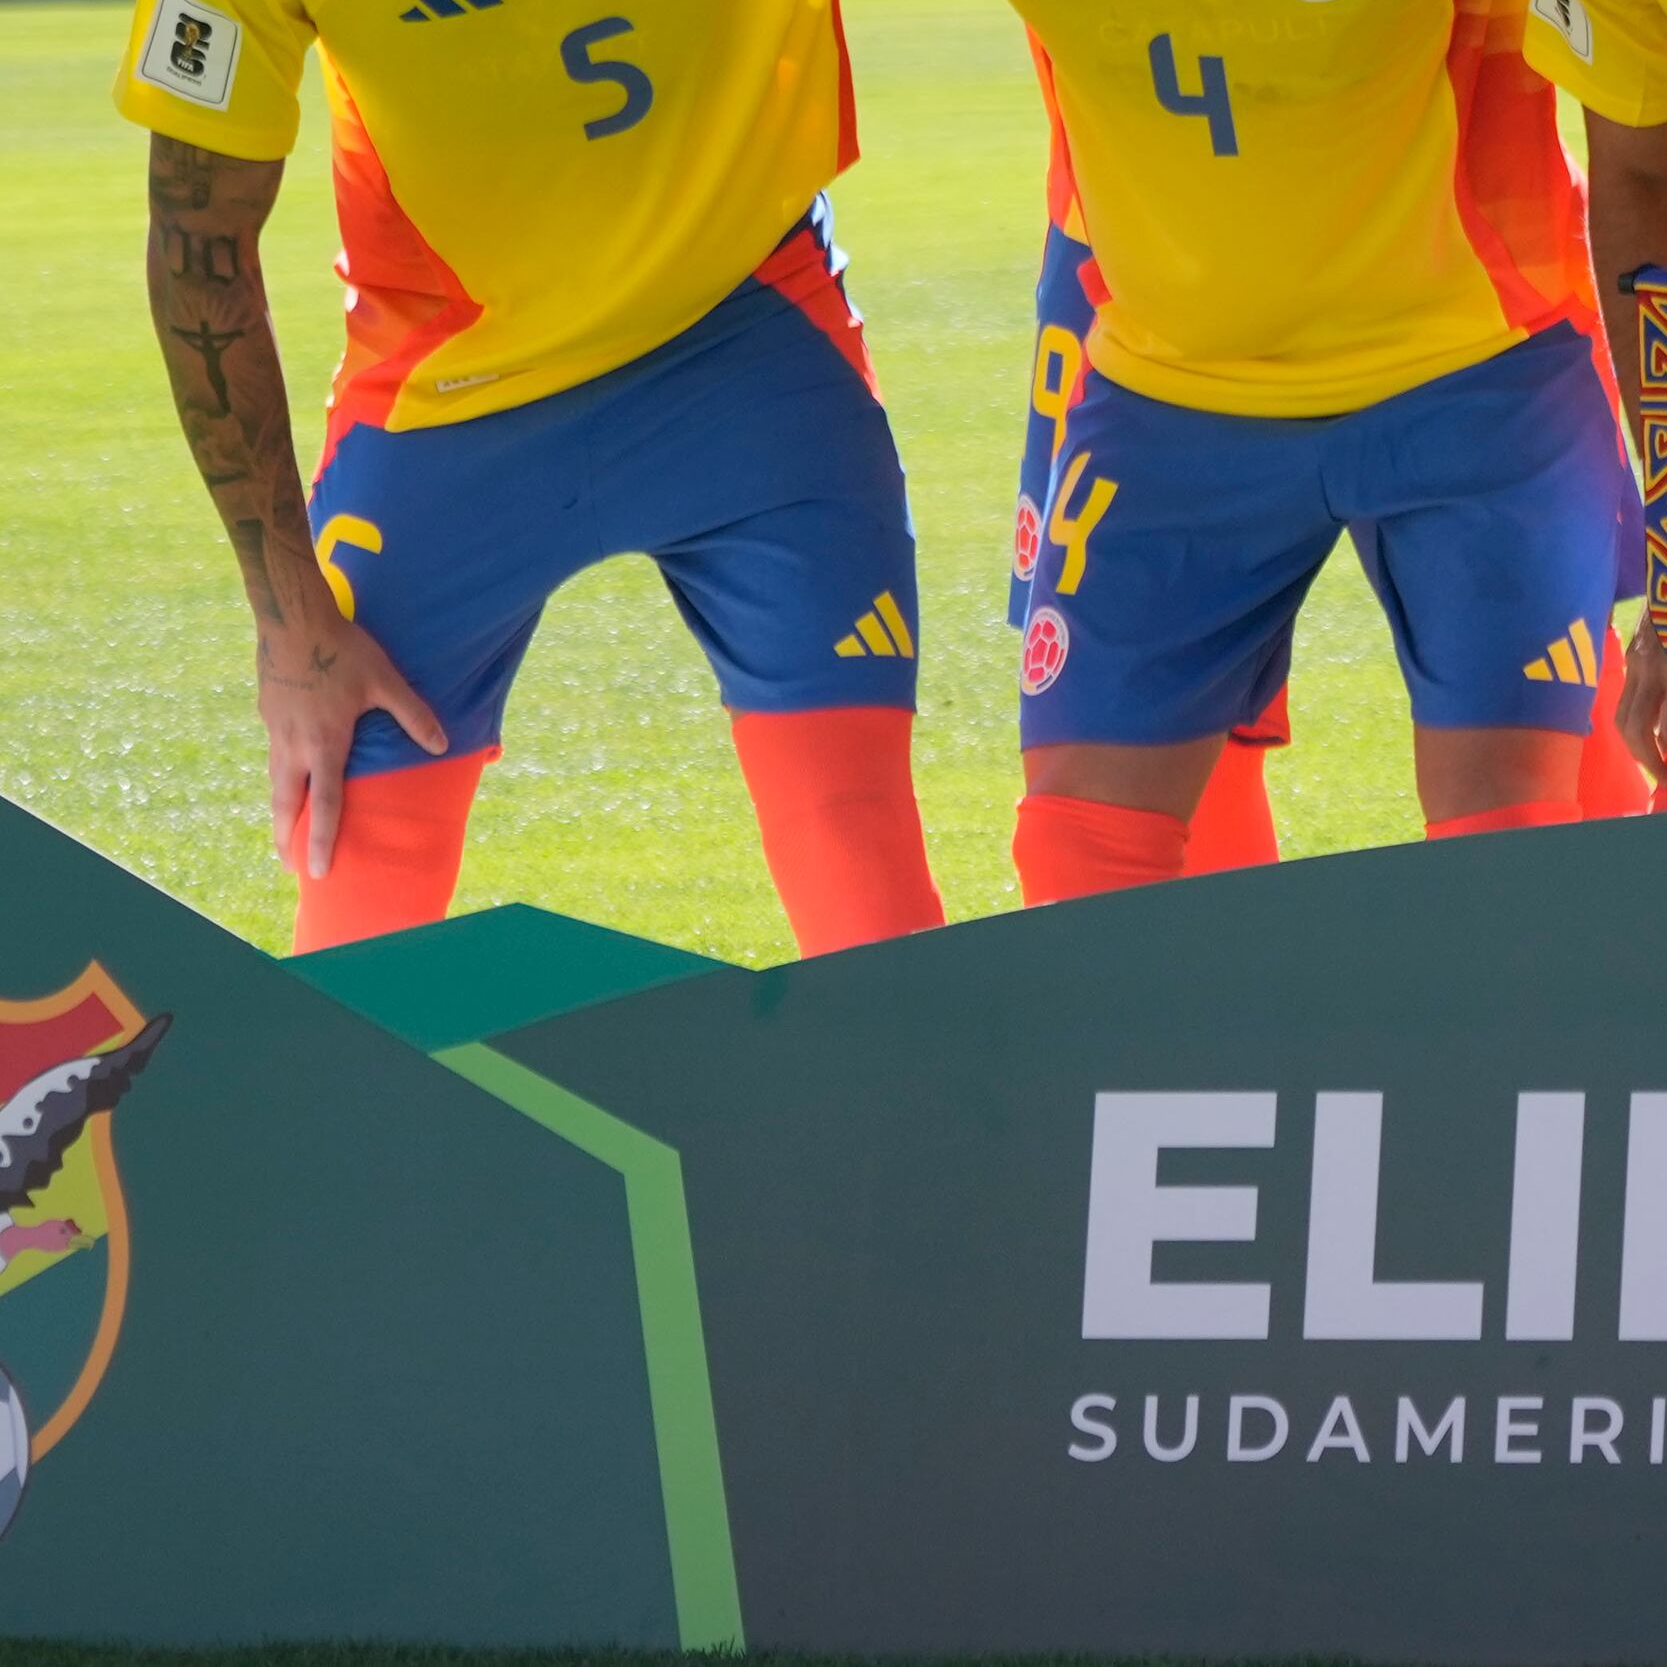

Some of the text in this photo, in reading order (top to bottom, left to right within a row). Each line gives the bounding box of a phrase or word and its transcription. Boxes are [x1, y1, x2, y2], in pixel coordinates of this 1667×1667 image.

[560, 16, 654, 141] 5
[1148, 32, 1239, 157] 4
[1049, 450, 1119, 596] 4
